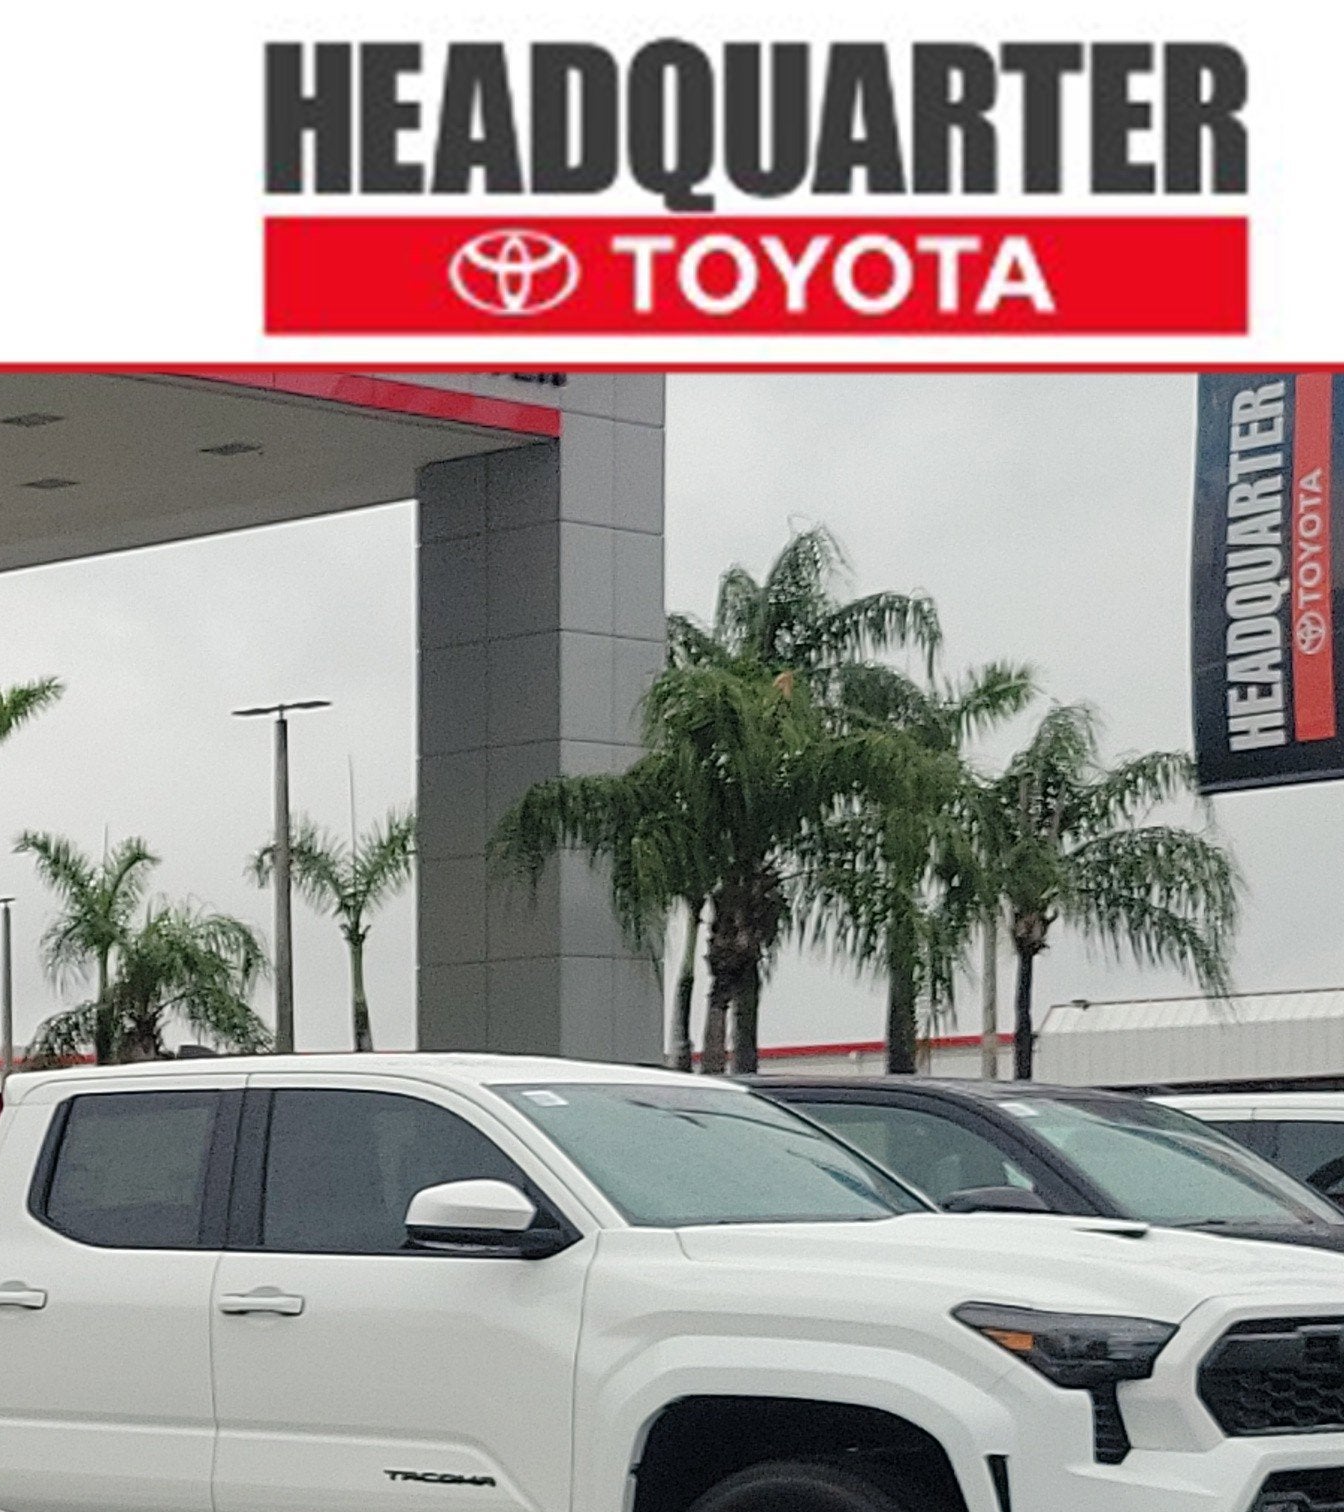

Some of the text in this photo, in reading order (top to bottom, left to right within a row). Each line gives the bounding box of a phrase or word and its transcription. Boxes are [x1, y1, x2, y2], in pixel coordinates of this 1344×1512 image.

[1226, 380, 1291, 752] HEADQUARTER
[1297, 468, 1325, 609] TOYOTA
[383, 1469, 496, 1487] TACOMA
